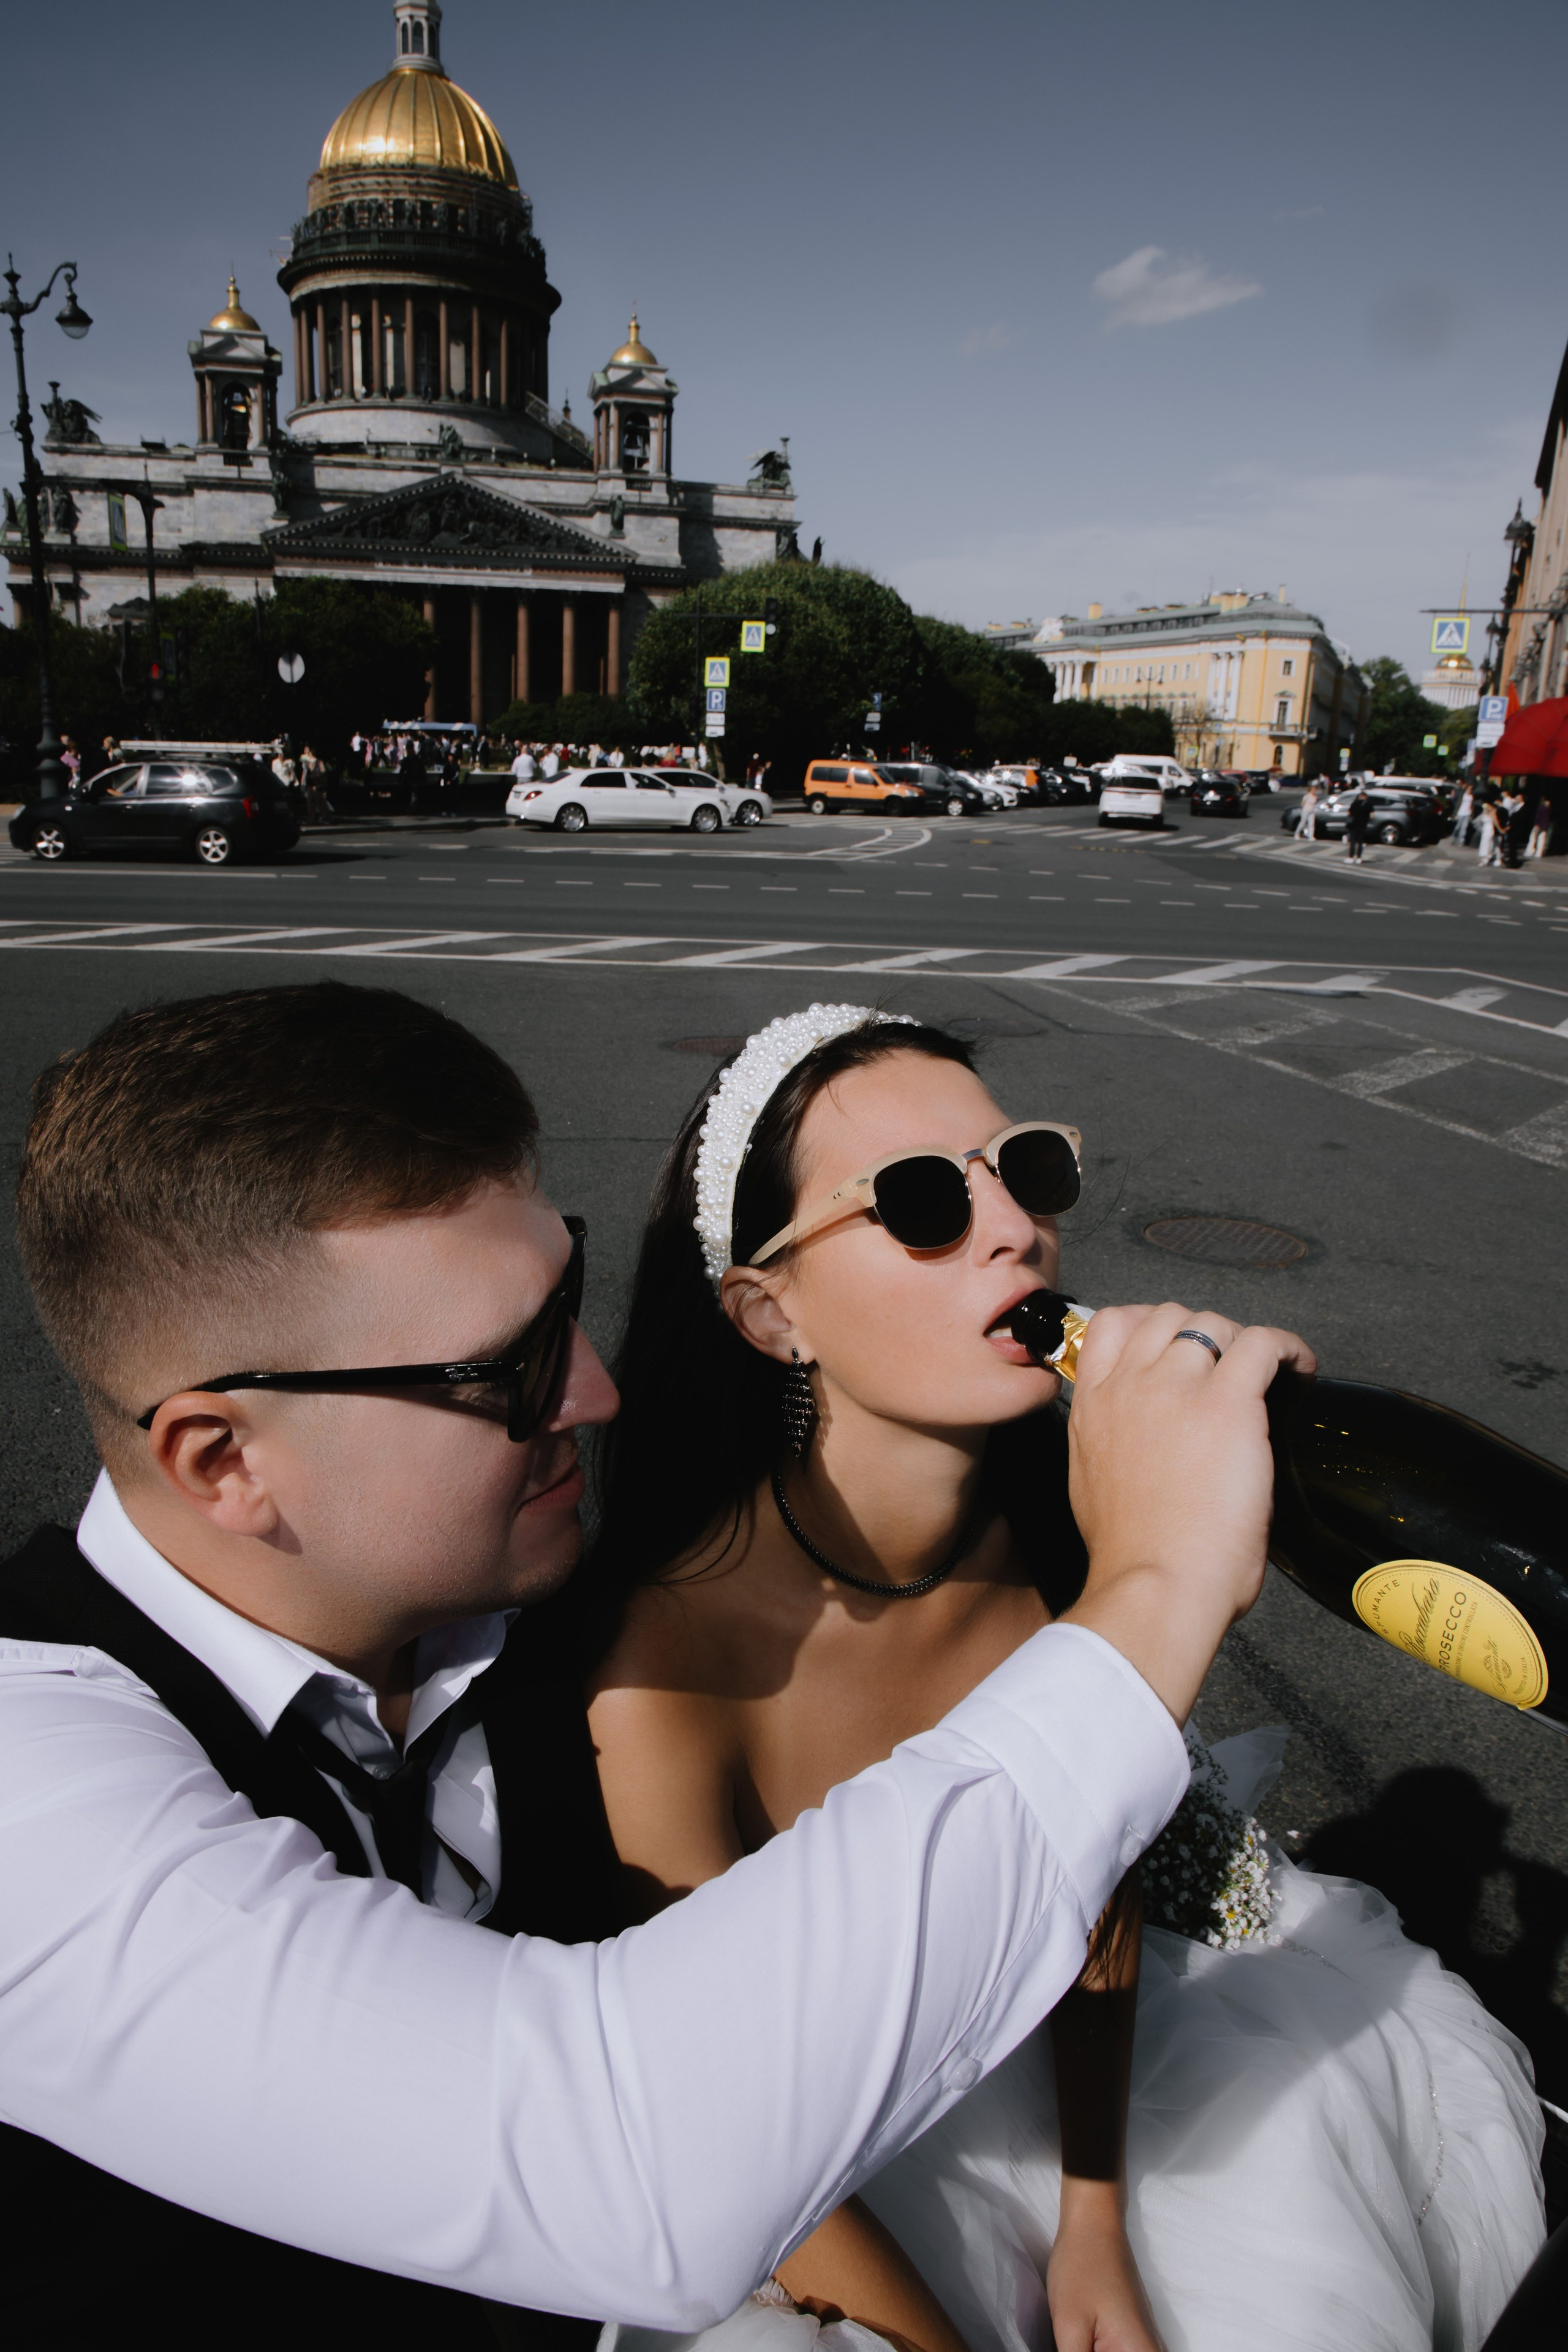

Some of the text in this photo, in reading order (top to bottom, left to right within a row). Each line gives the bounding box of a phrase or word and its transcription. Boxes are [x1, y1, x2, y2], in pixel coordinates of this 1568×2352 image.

[1372, 1579, 1400, 1635] SPUMANTE
[1439, 1591, 1466, 1673] PROSECCO
[1458, 1634, 1467, 1651] ORIGINE
[1463, 1602, 1479, 1634] CONTROLLATA
[1512, 1680, 1526, 1695] PRODOTTO
